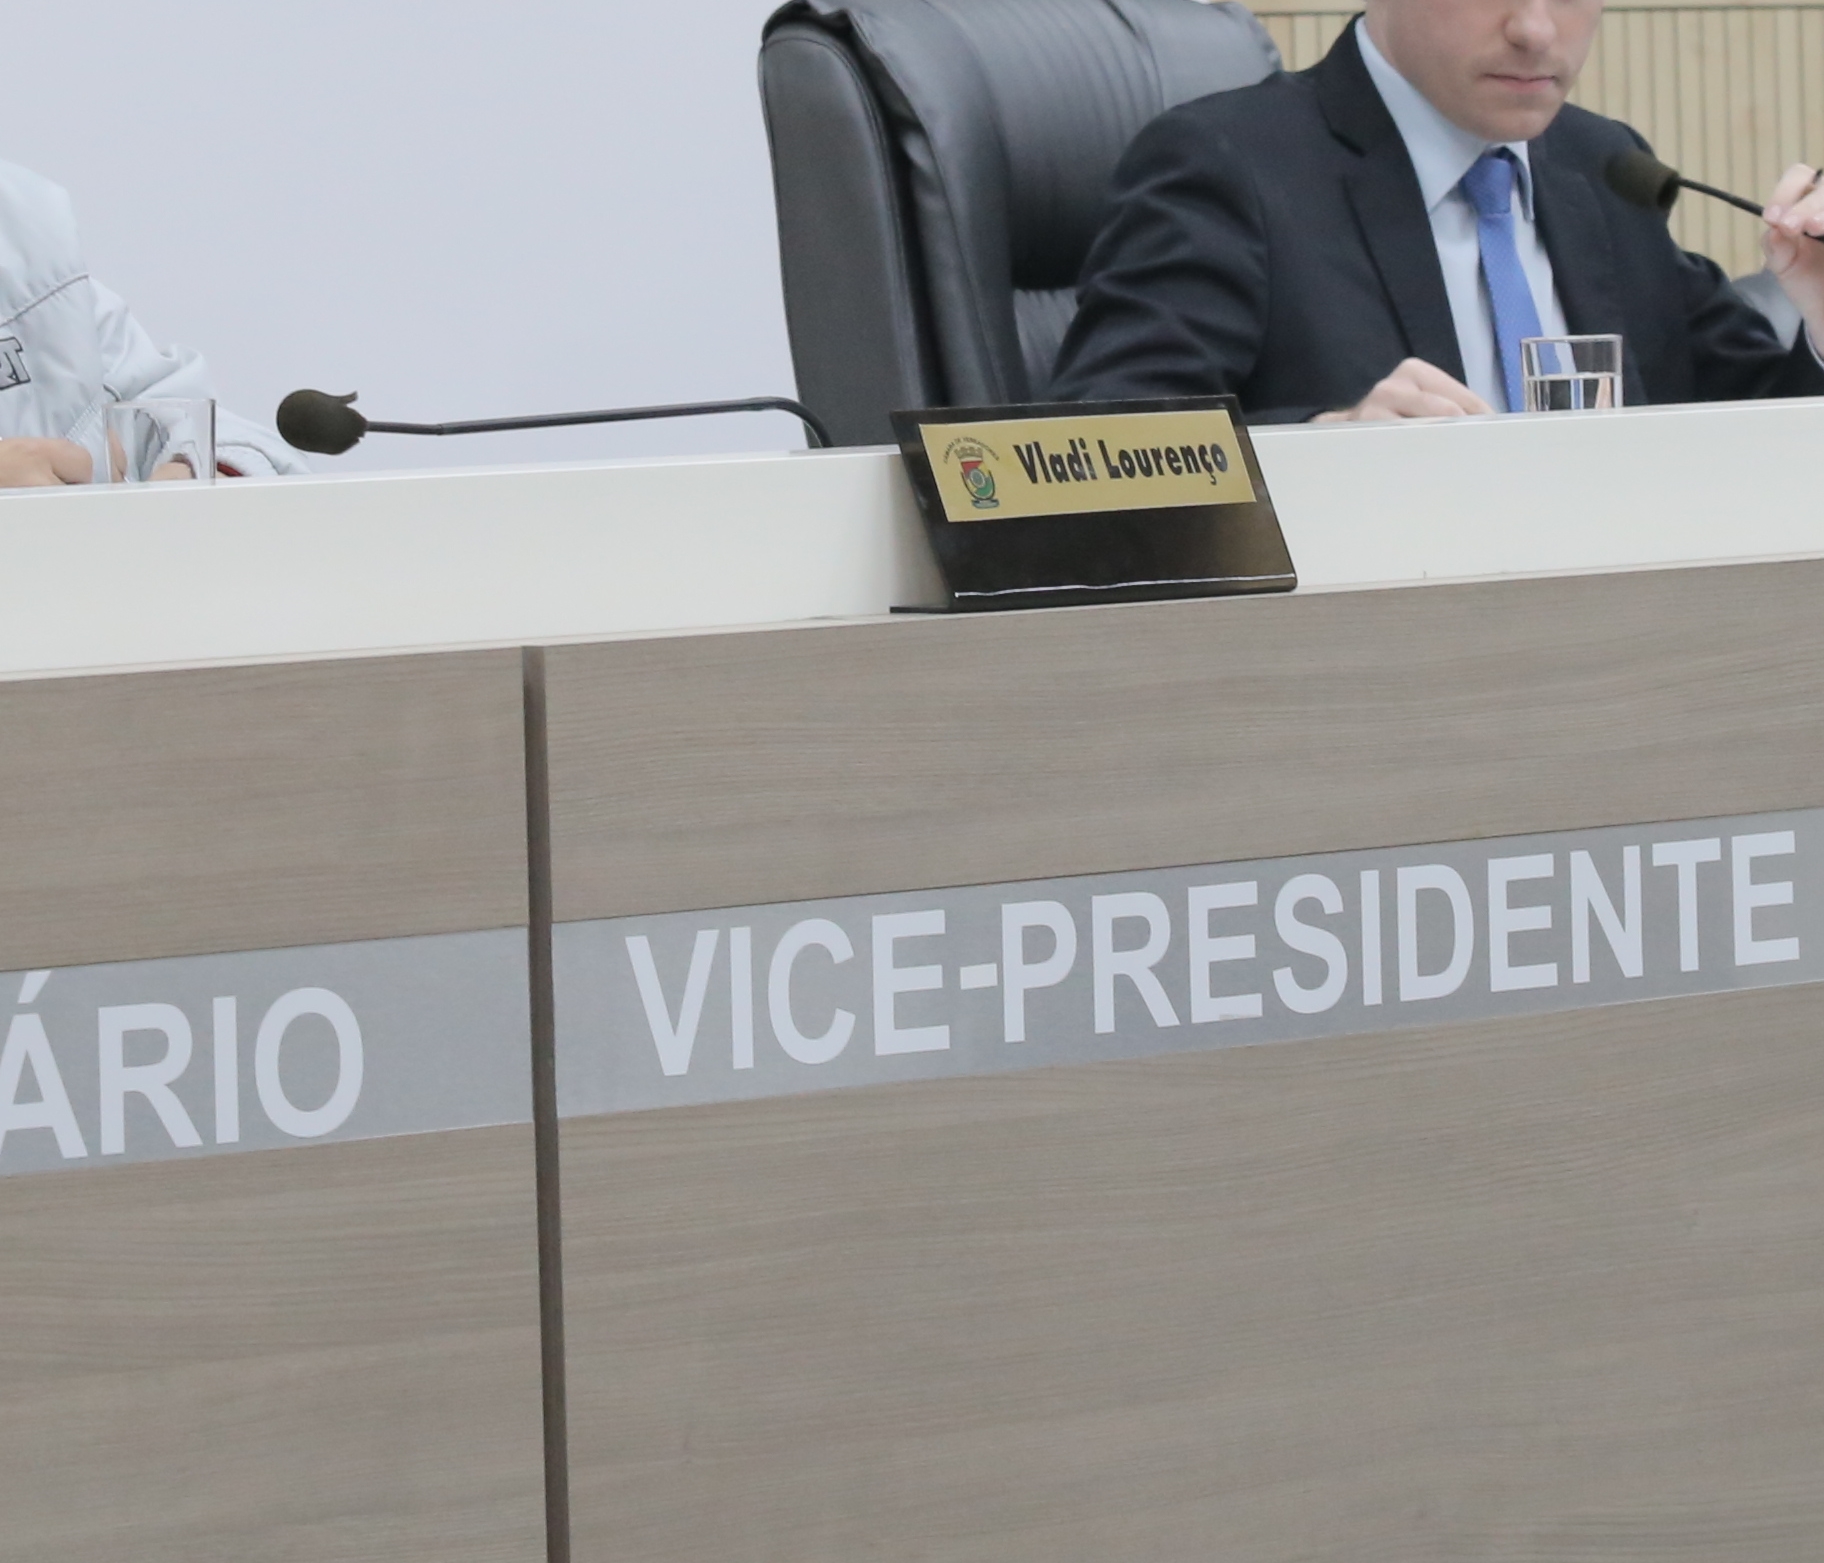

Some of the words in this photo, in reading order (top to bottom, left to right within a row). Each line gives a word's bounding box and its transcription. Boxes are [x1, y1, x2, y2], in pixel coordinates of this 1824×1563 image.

[1013, 437, 1098, 485] Vladi
[1097, 439, 1228, 486] Lourenço
[624, 829, 1801, 1078] VICE-PRESIDENTE
